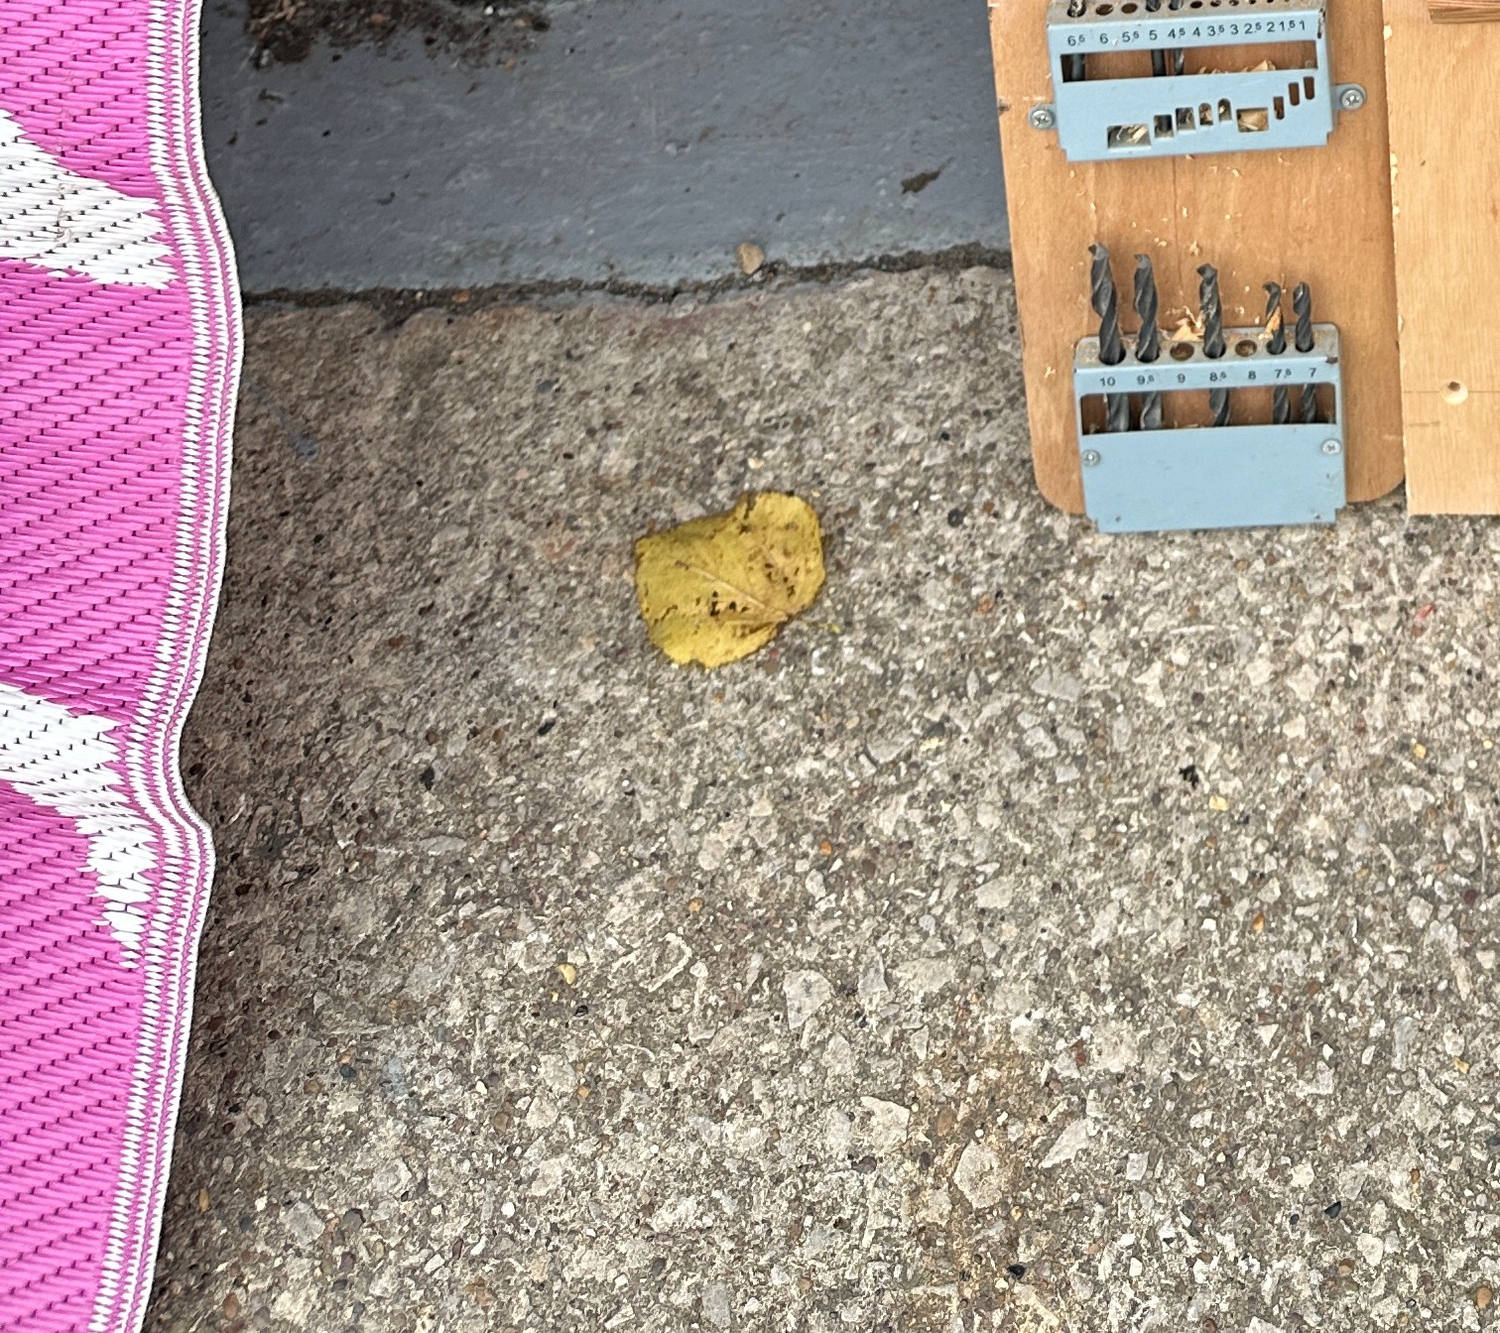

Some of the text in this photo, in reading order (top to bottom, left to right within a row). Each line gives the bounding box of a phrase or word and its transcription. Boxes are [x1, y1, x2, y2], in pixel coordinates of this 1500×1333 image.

[1099, 32, 1109, 44] 6
[1149, 29, 1158, 41] 5
[1192, 26, 1201, 37] 4
[1230, 23, 1239, 35] 3
[1266, 21, 1275, 33] 2
[1299, 20, 1306, 31] 1
[1099, 376, 1116, 387] 10
[1177, 373, 1186, 383] 9
[1248, 370, 1257, 380] 8
[1309, 367, 1317, 378] 7
